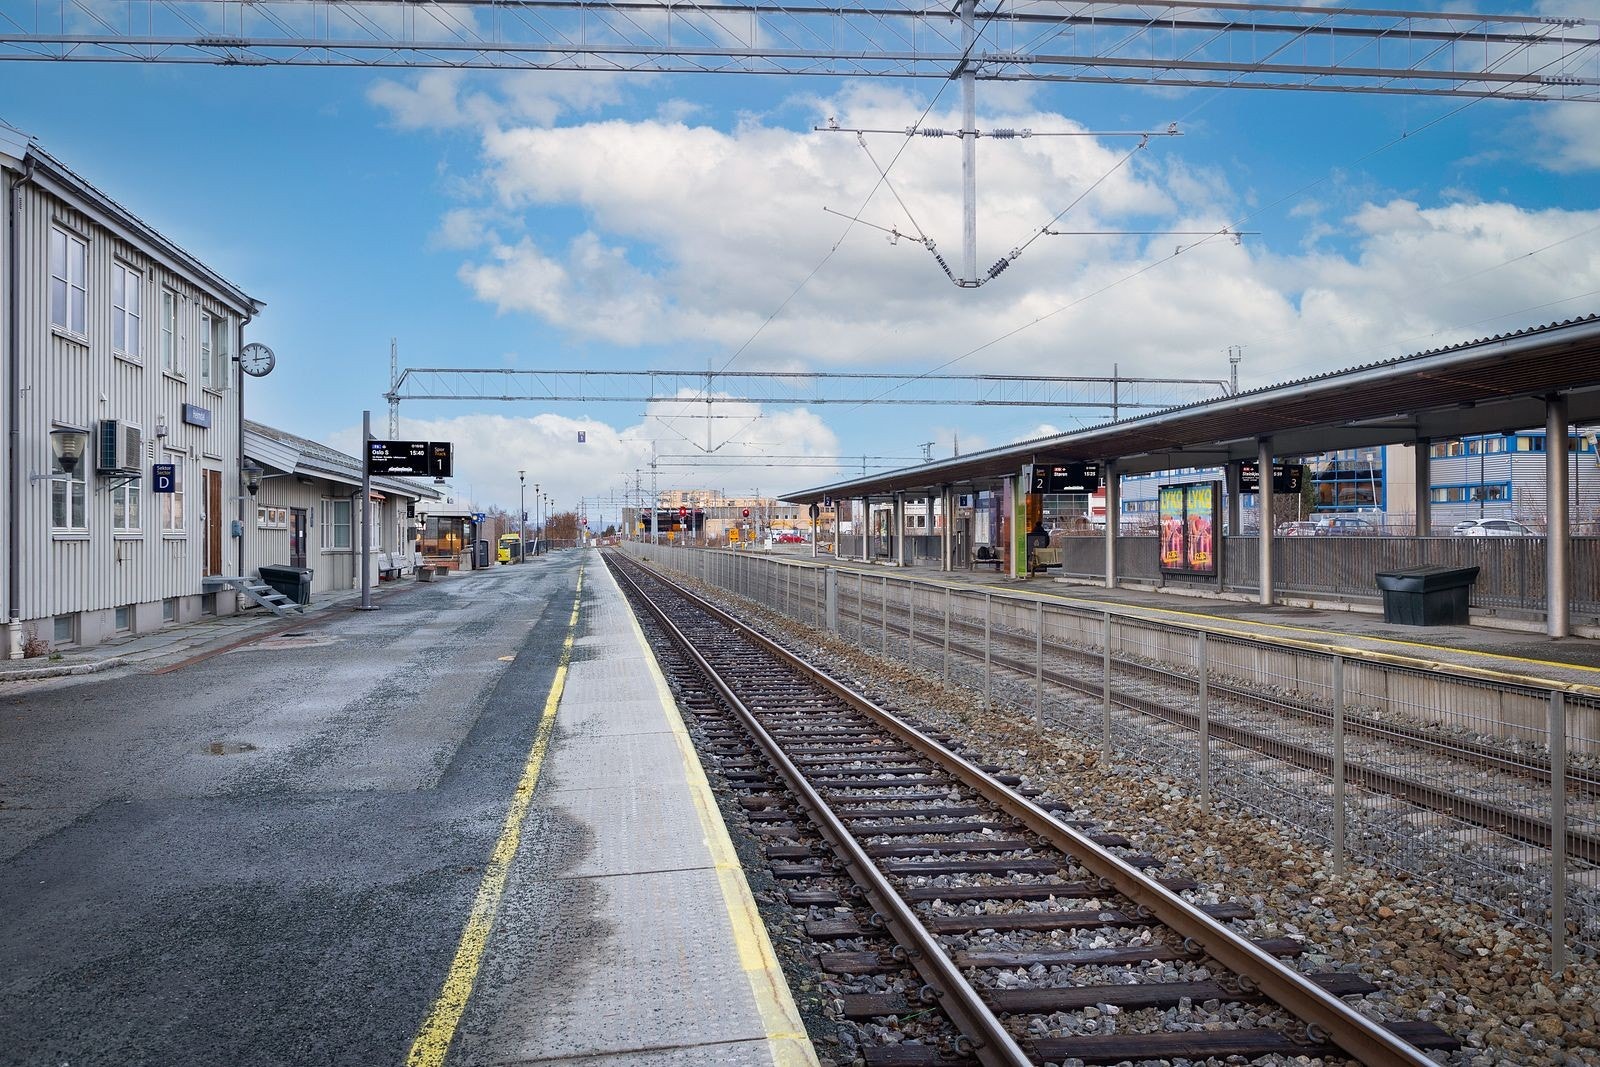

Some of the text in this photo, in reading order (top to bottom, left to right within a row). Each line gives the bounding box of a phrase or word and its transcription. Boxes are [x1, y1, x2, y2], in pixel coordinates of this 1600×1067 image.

[437, 458, 442, 470] 1
[160, 476, 170, 488] D
[1036, 478, 1043, 488] 2
[1290, 478, 1296, 488] 3
